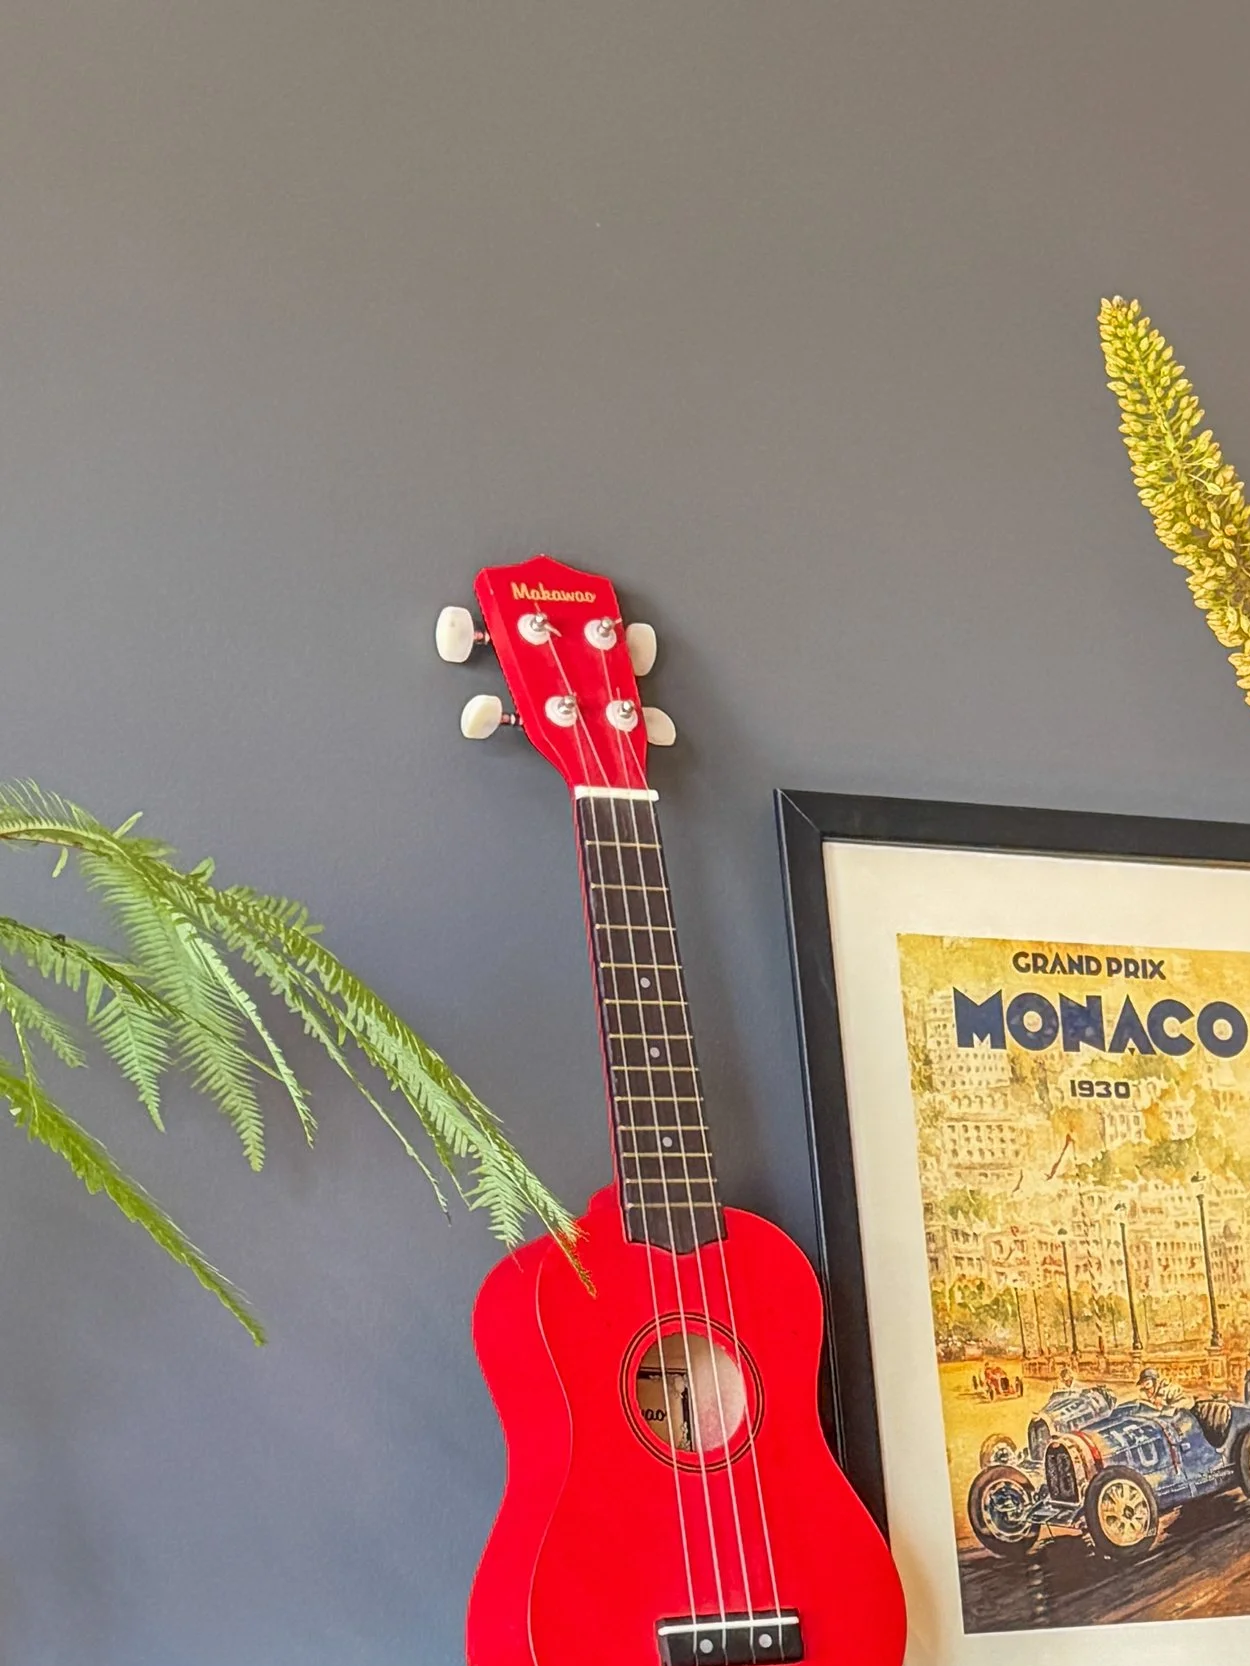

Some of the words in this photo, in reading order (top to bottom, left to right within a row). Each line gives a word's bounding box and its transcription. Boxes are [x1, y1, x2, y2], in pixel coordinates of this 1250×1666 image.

[511, 581, 596, 603] Makawao
[1012, 951, 1101, 976] GRAND
[1106, 957, 1166, 980] PRIX
[952, 986, 1249, 1058] MONACO
[1070, 1080, 1131, 1099] 1930
